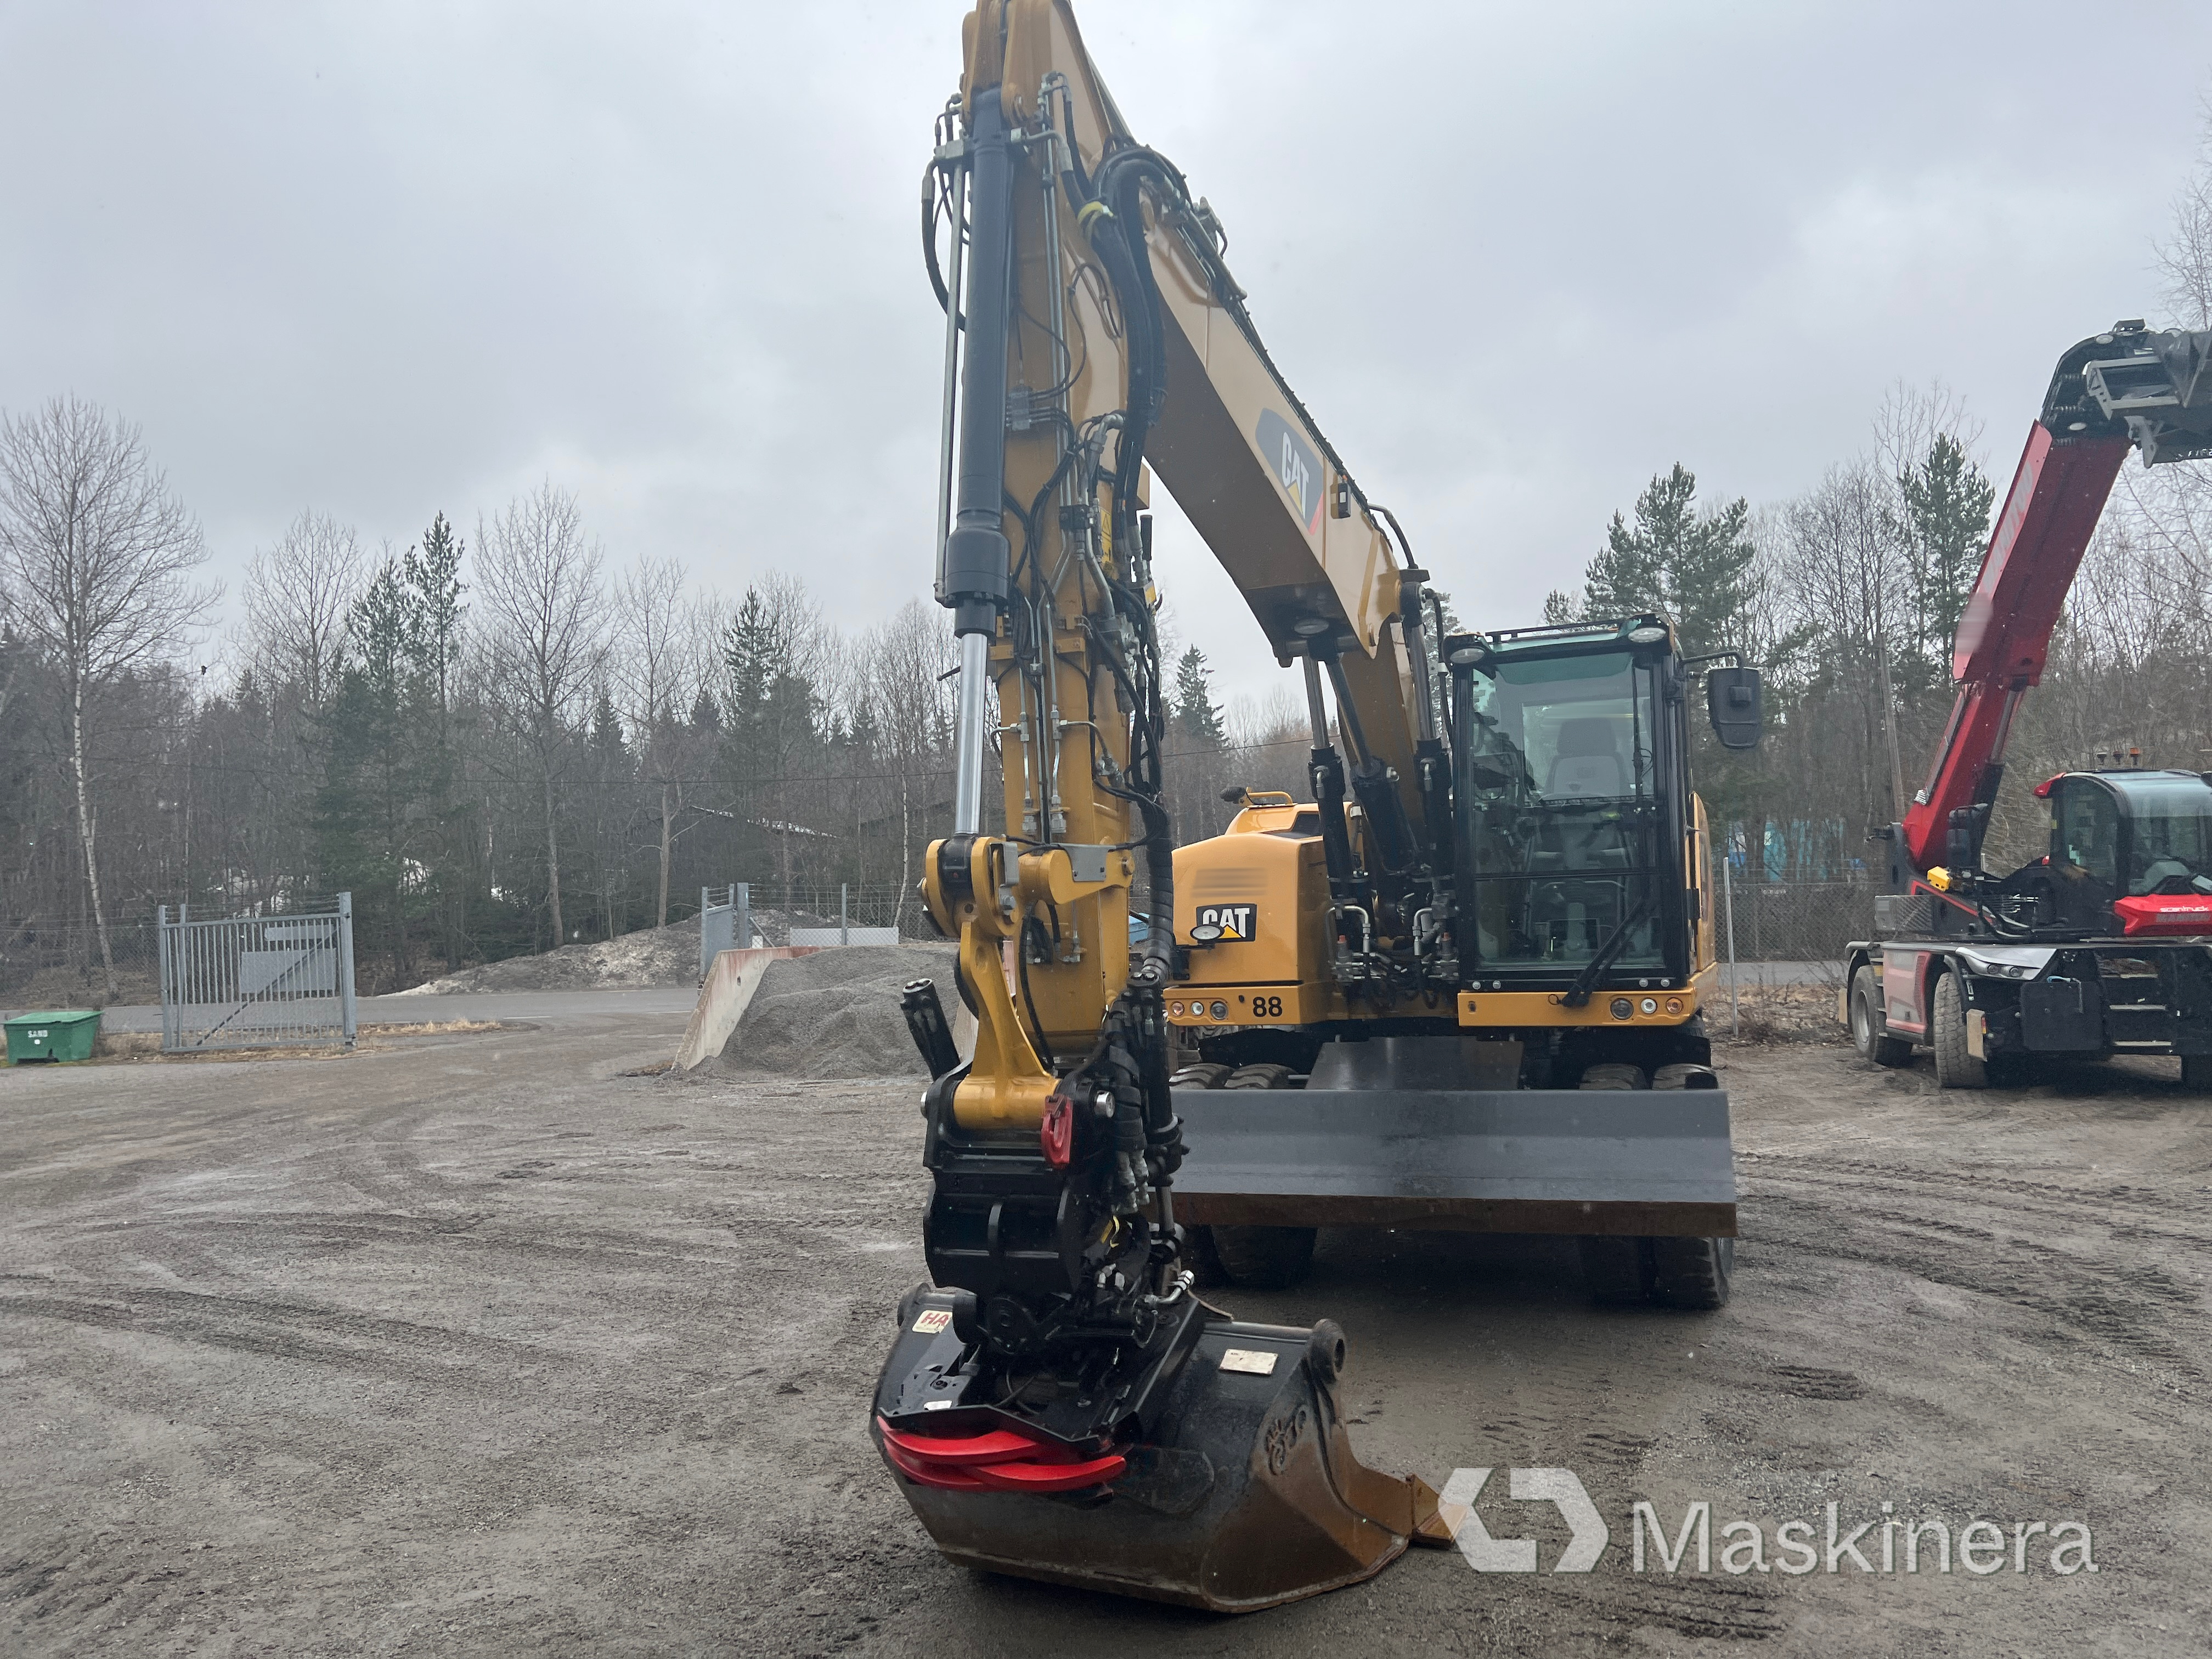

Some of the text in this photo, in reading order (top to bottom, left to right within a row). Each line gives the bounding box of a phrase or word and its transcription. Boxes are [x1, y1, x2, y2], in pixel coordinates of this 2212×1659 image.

[1282, 432, 1310, 519] CAT
[1203, 907, 1250, 938] CAT
[1253, 996, 1283, 1017] 88
[921, 1313, 949, 1326] HA
